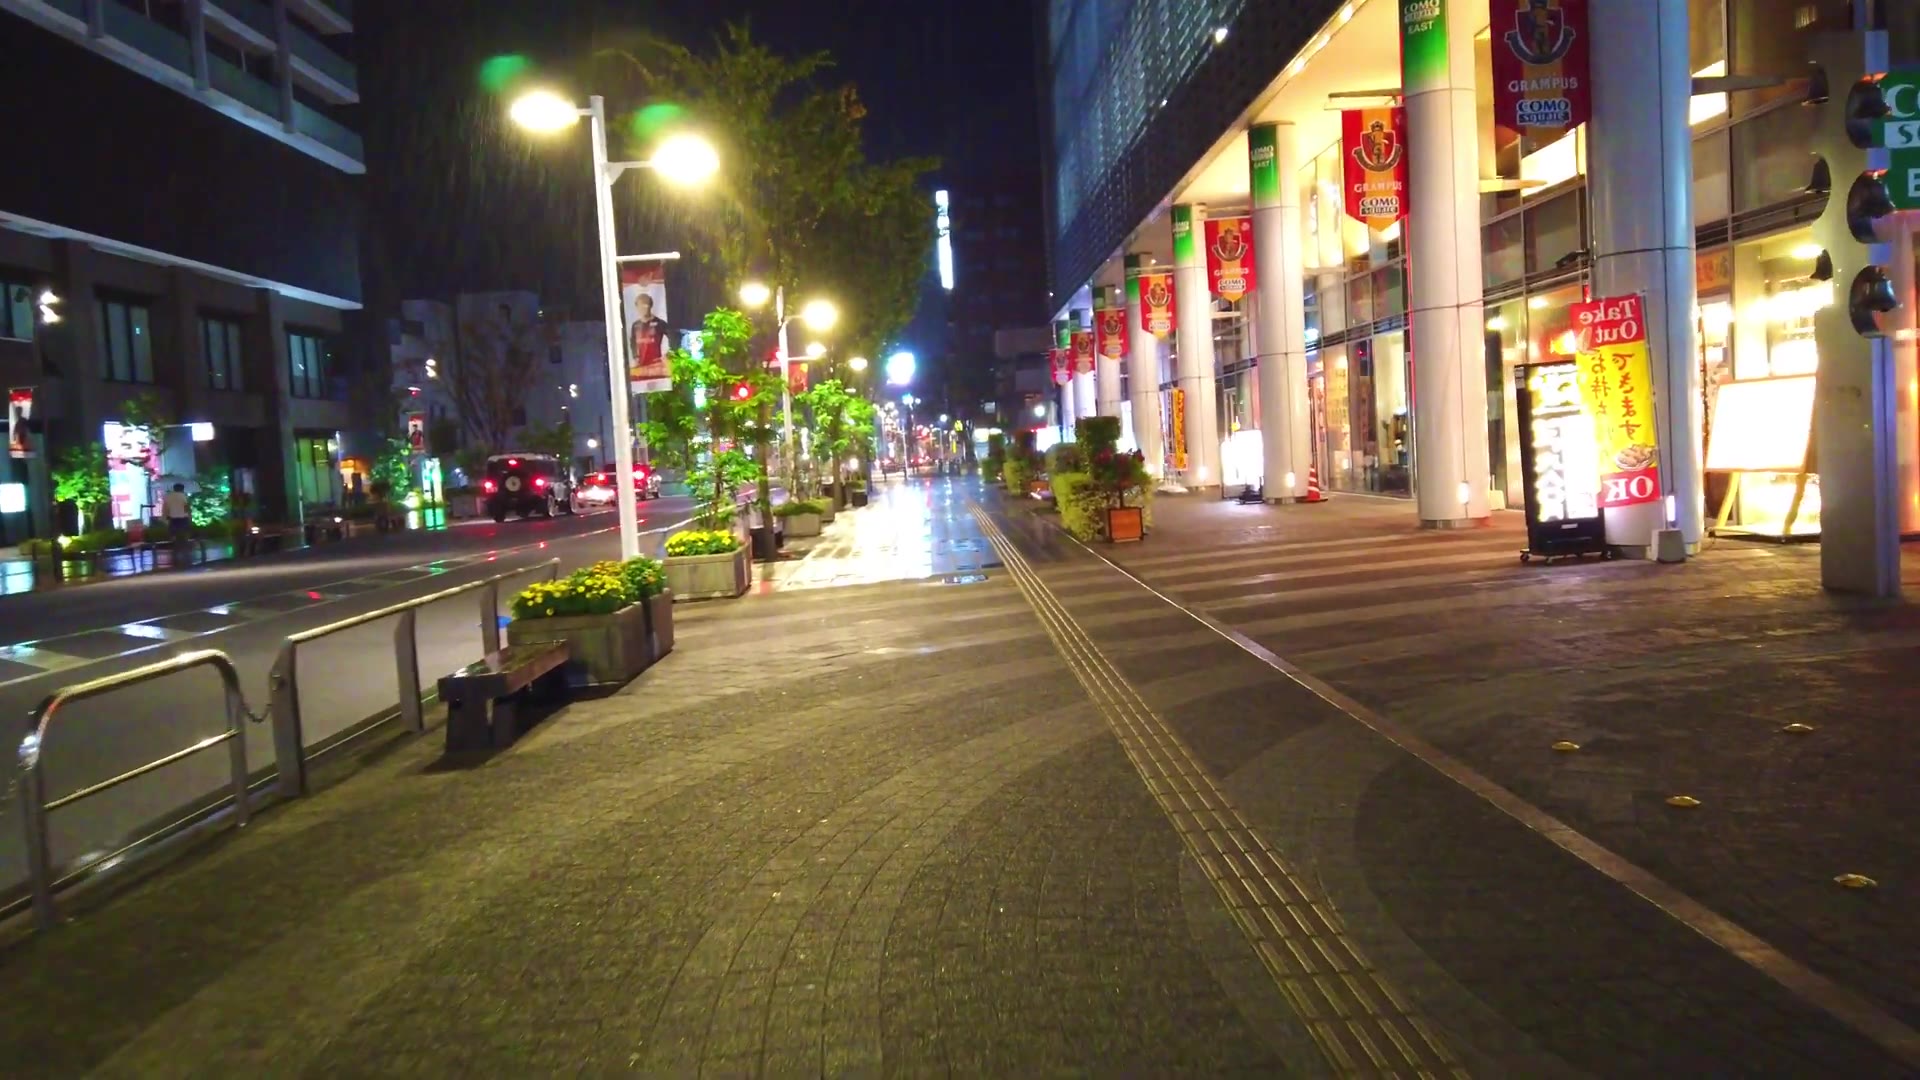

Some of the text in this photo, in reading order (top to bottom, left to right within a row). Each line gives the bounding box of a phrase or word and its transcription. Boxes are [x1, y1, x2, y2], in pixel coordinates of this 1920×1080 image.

[1408, 21, 1435, 34] EAST
[1508, 76, 1578, 93] GRAMPUS
[1517, 98, 1570, 112] COMO
[1360, 196, 1398, 207] COMO
